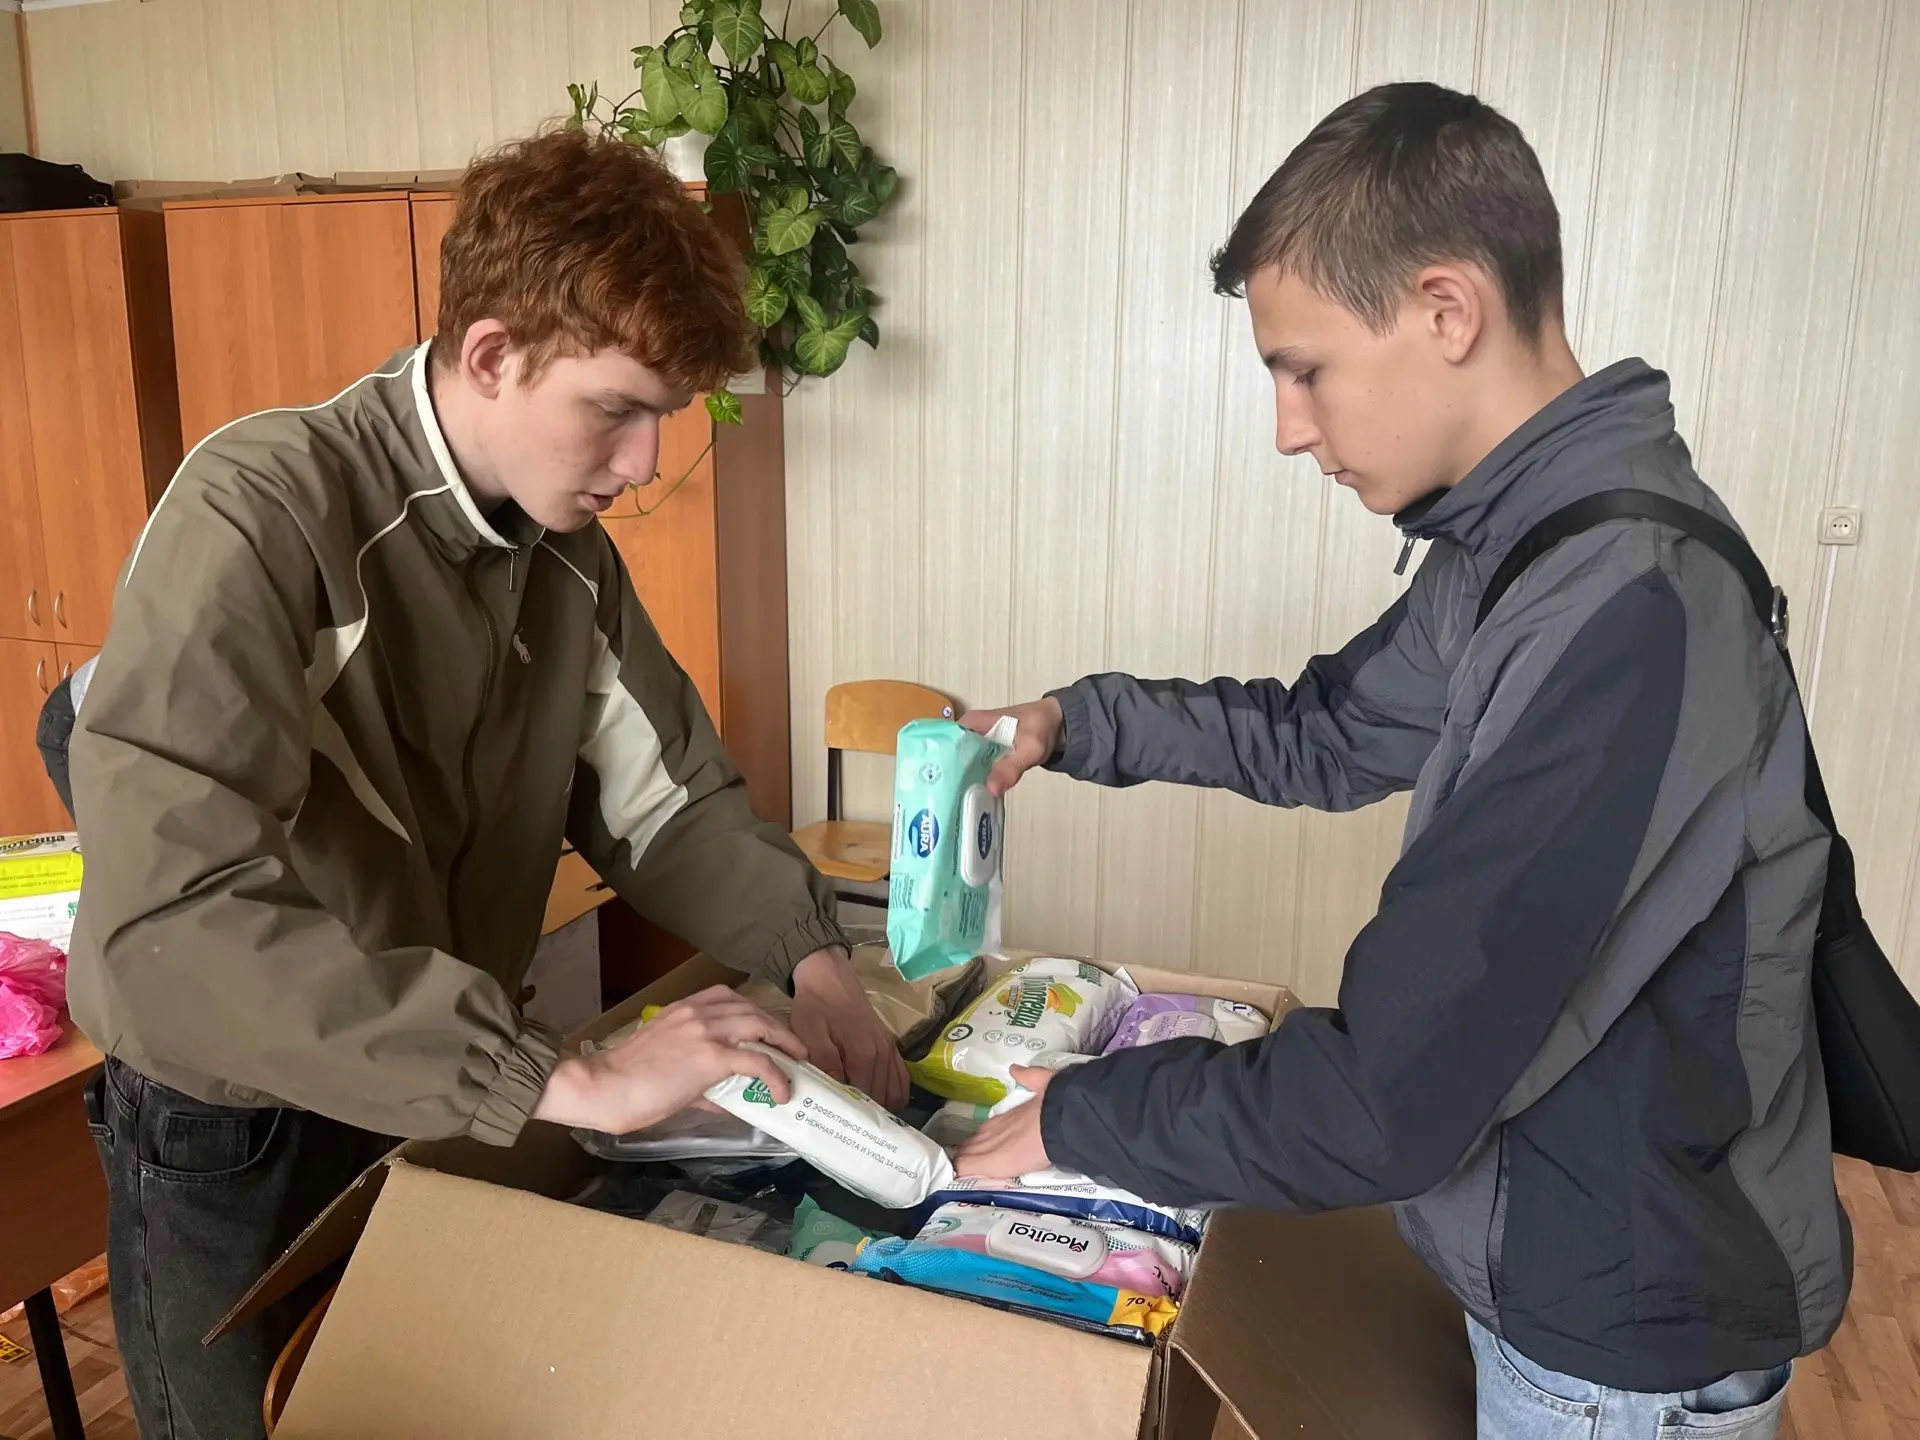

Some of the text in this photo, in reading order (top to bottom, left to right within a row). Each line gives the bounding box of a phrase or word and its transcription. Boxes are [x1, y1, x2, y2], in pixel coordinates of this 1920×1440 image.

[919, 814, 931, 853] AURA
[812, 1103, 898, 1153] ЭФФЕКТИВНОЕ ОЧИЩЕНИЕ
[804, 1116, 834, 1136] НЕЖНАЯ
[833, 1132, 861, 1151] ЗАБОТА
[866, 1150, 886, 1165] УХОД
[884, 1159, 895, 1169] ЗА
[894, 1163, 919, 1180] КОЖЕЙ
[1008, 1222, 1090, 1253] Maditol
[1126, 1297, 1146, 1307] 70
